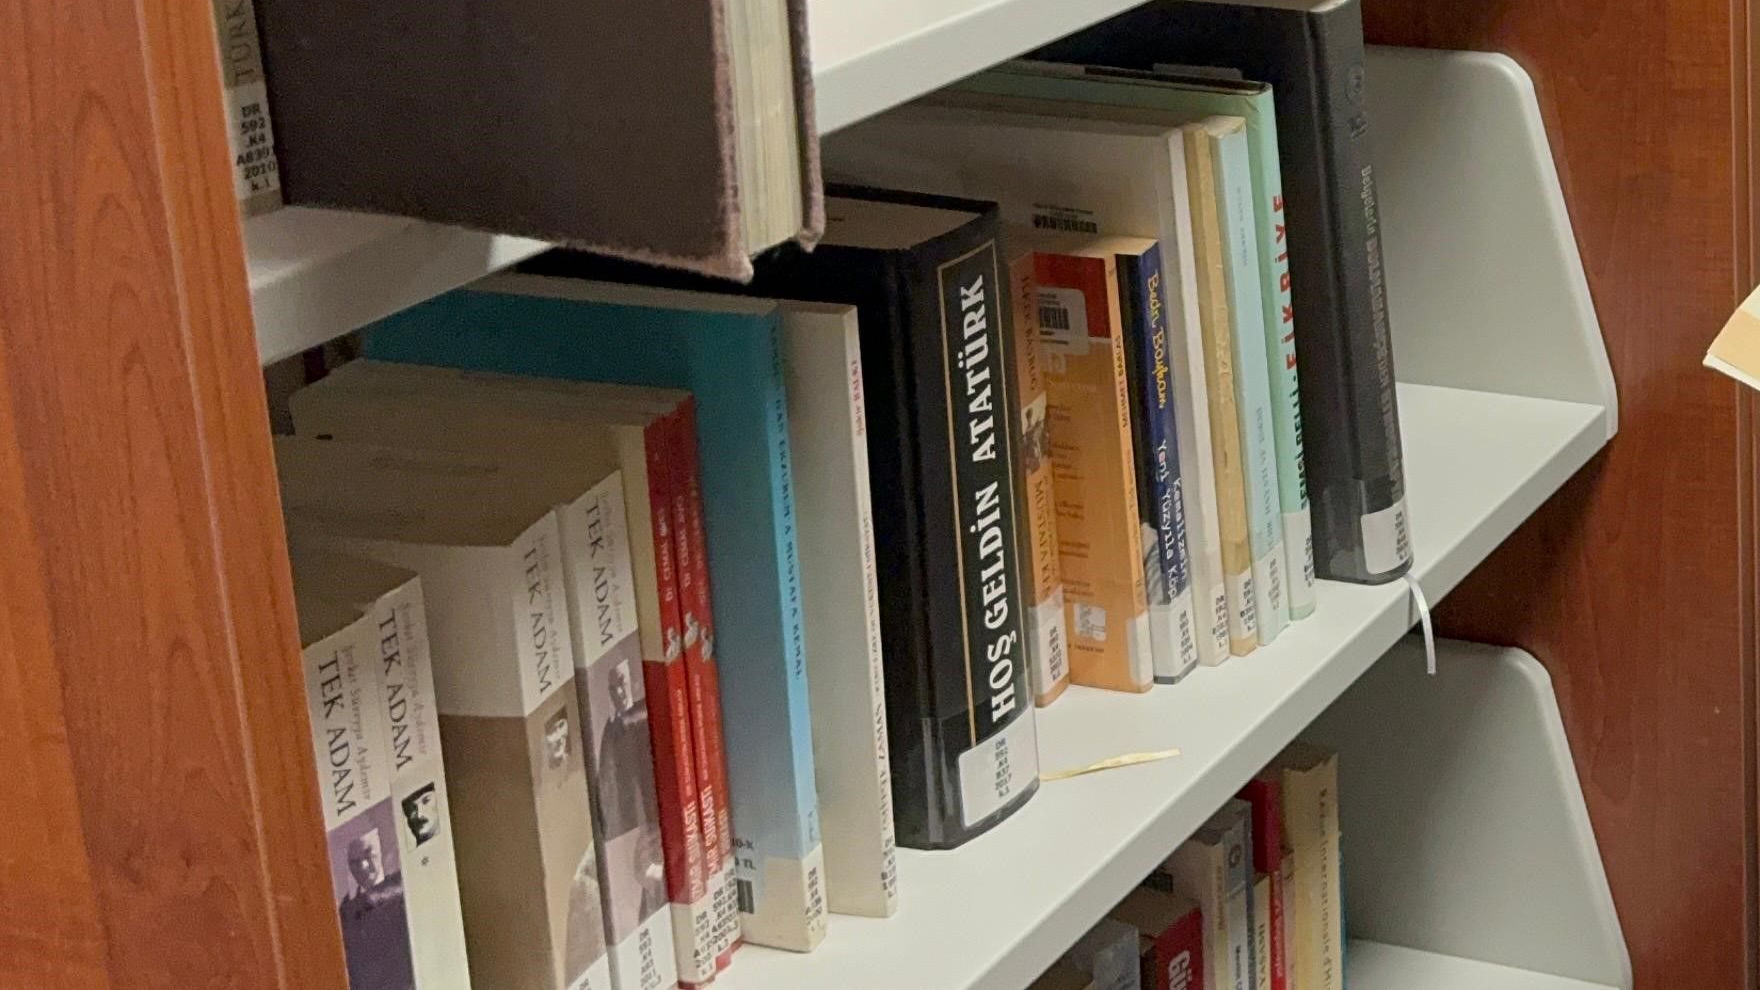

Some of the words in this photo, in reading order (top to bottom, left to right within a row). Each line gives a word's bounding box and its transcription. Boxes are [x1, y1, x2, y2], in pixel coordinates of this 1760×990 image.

[957, 274, 997, 463] ATATÜRK
[1154, 439, 1169, 483] Yeni
[585, 503, 607, 559] TEK
[969, 479, 1010, 631] GELDİN
[523, 546, 544, 606] TEK
[592, 565, 614, 647] ADAM
[317, 649, 346, 720] TEK
[379, 608, 402, 678] TEK
[530, 611, 552, 696] ADAM
[986, 629, 1016, 723] HOŞ
[386, 683, 414, 772] ADAM
[326, 725, 358, 818] ADAM
